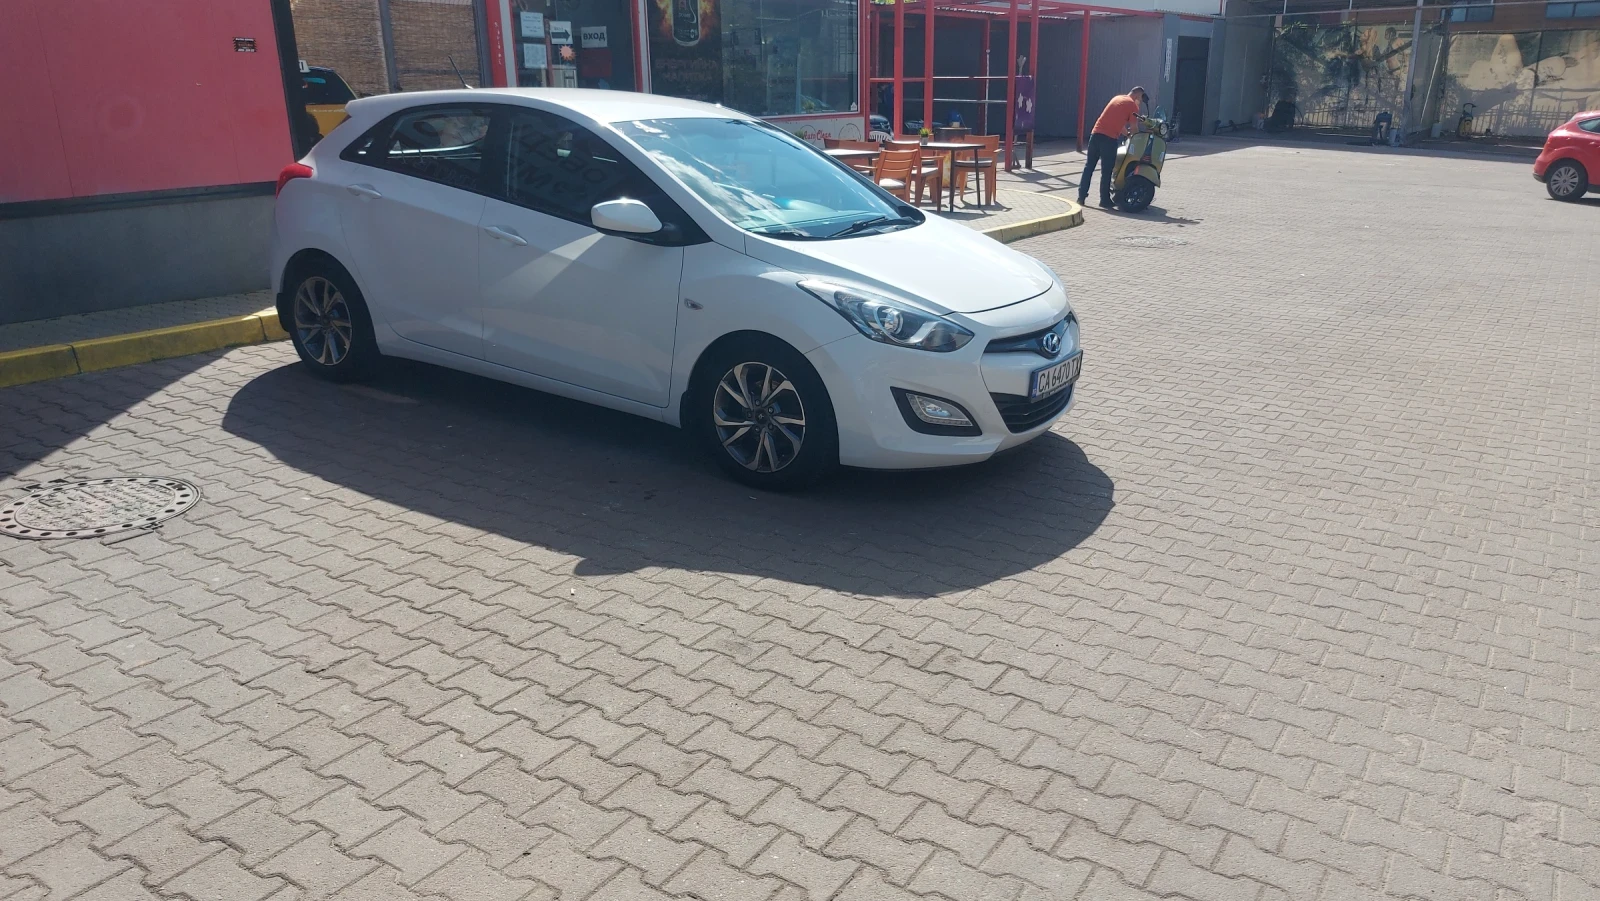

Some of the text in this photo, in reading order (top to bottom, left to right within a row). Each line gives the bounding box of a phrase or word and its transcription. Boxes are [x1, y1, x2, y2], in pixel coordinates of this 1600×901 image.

[583, 32, 606, 42] ВХОД
[1039, 371, 1050, 392] CA
[1052, 361, 1071, 386] 6470
